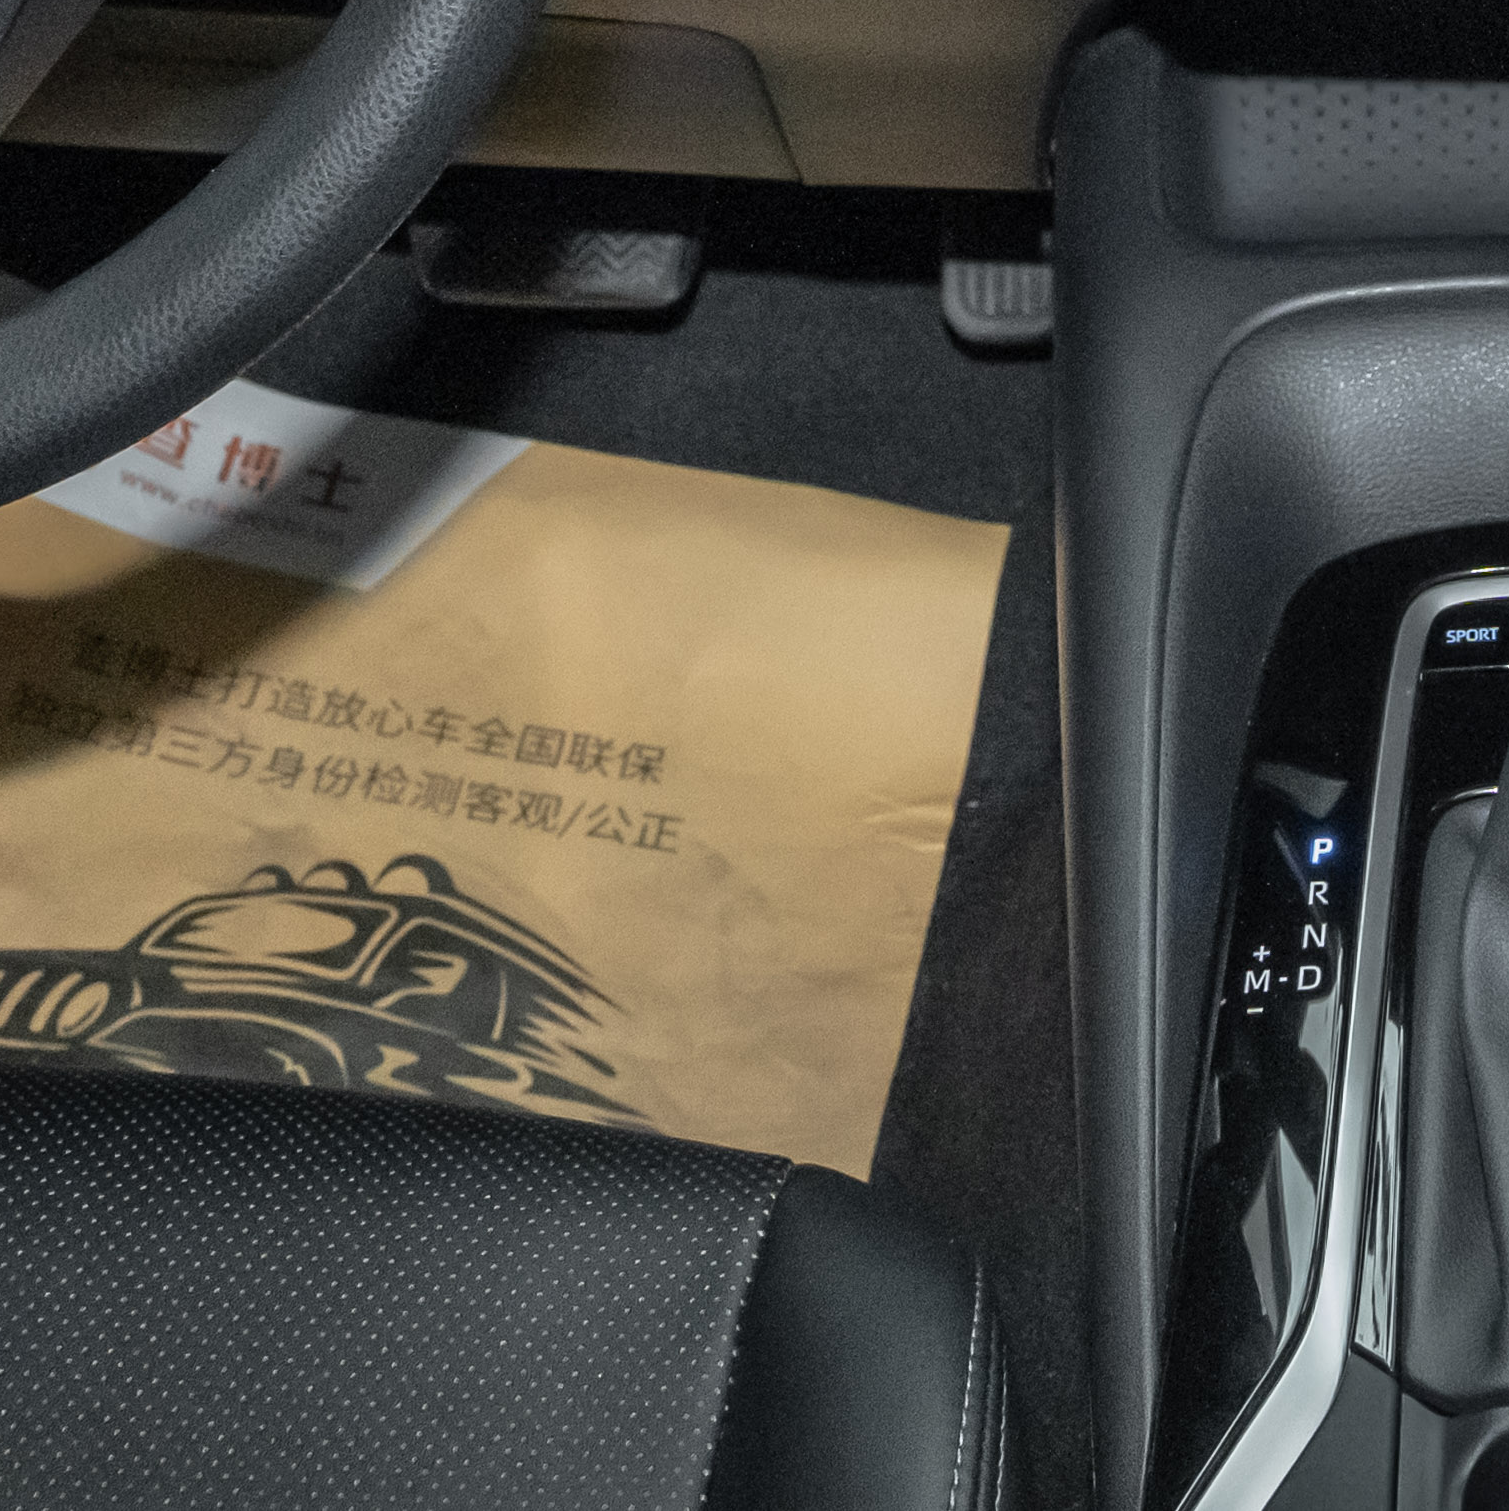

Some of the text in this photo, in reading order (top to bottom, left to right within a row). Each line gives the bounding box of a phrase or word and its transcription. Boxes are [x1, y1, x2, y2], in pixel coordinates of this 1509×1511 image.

[1445, 626, 1500, 644] SPORT
[1310, 837, 1335, 865] P
[1307, 880, 1329, 906] R
[1302, 923, 1328, 950] N
[1243, 965, 1322, 995] M D
